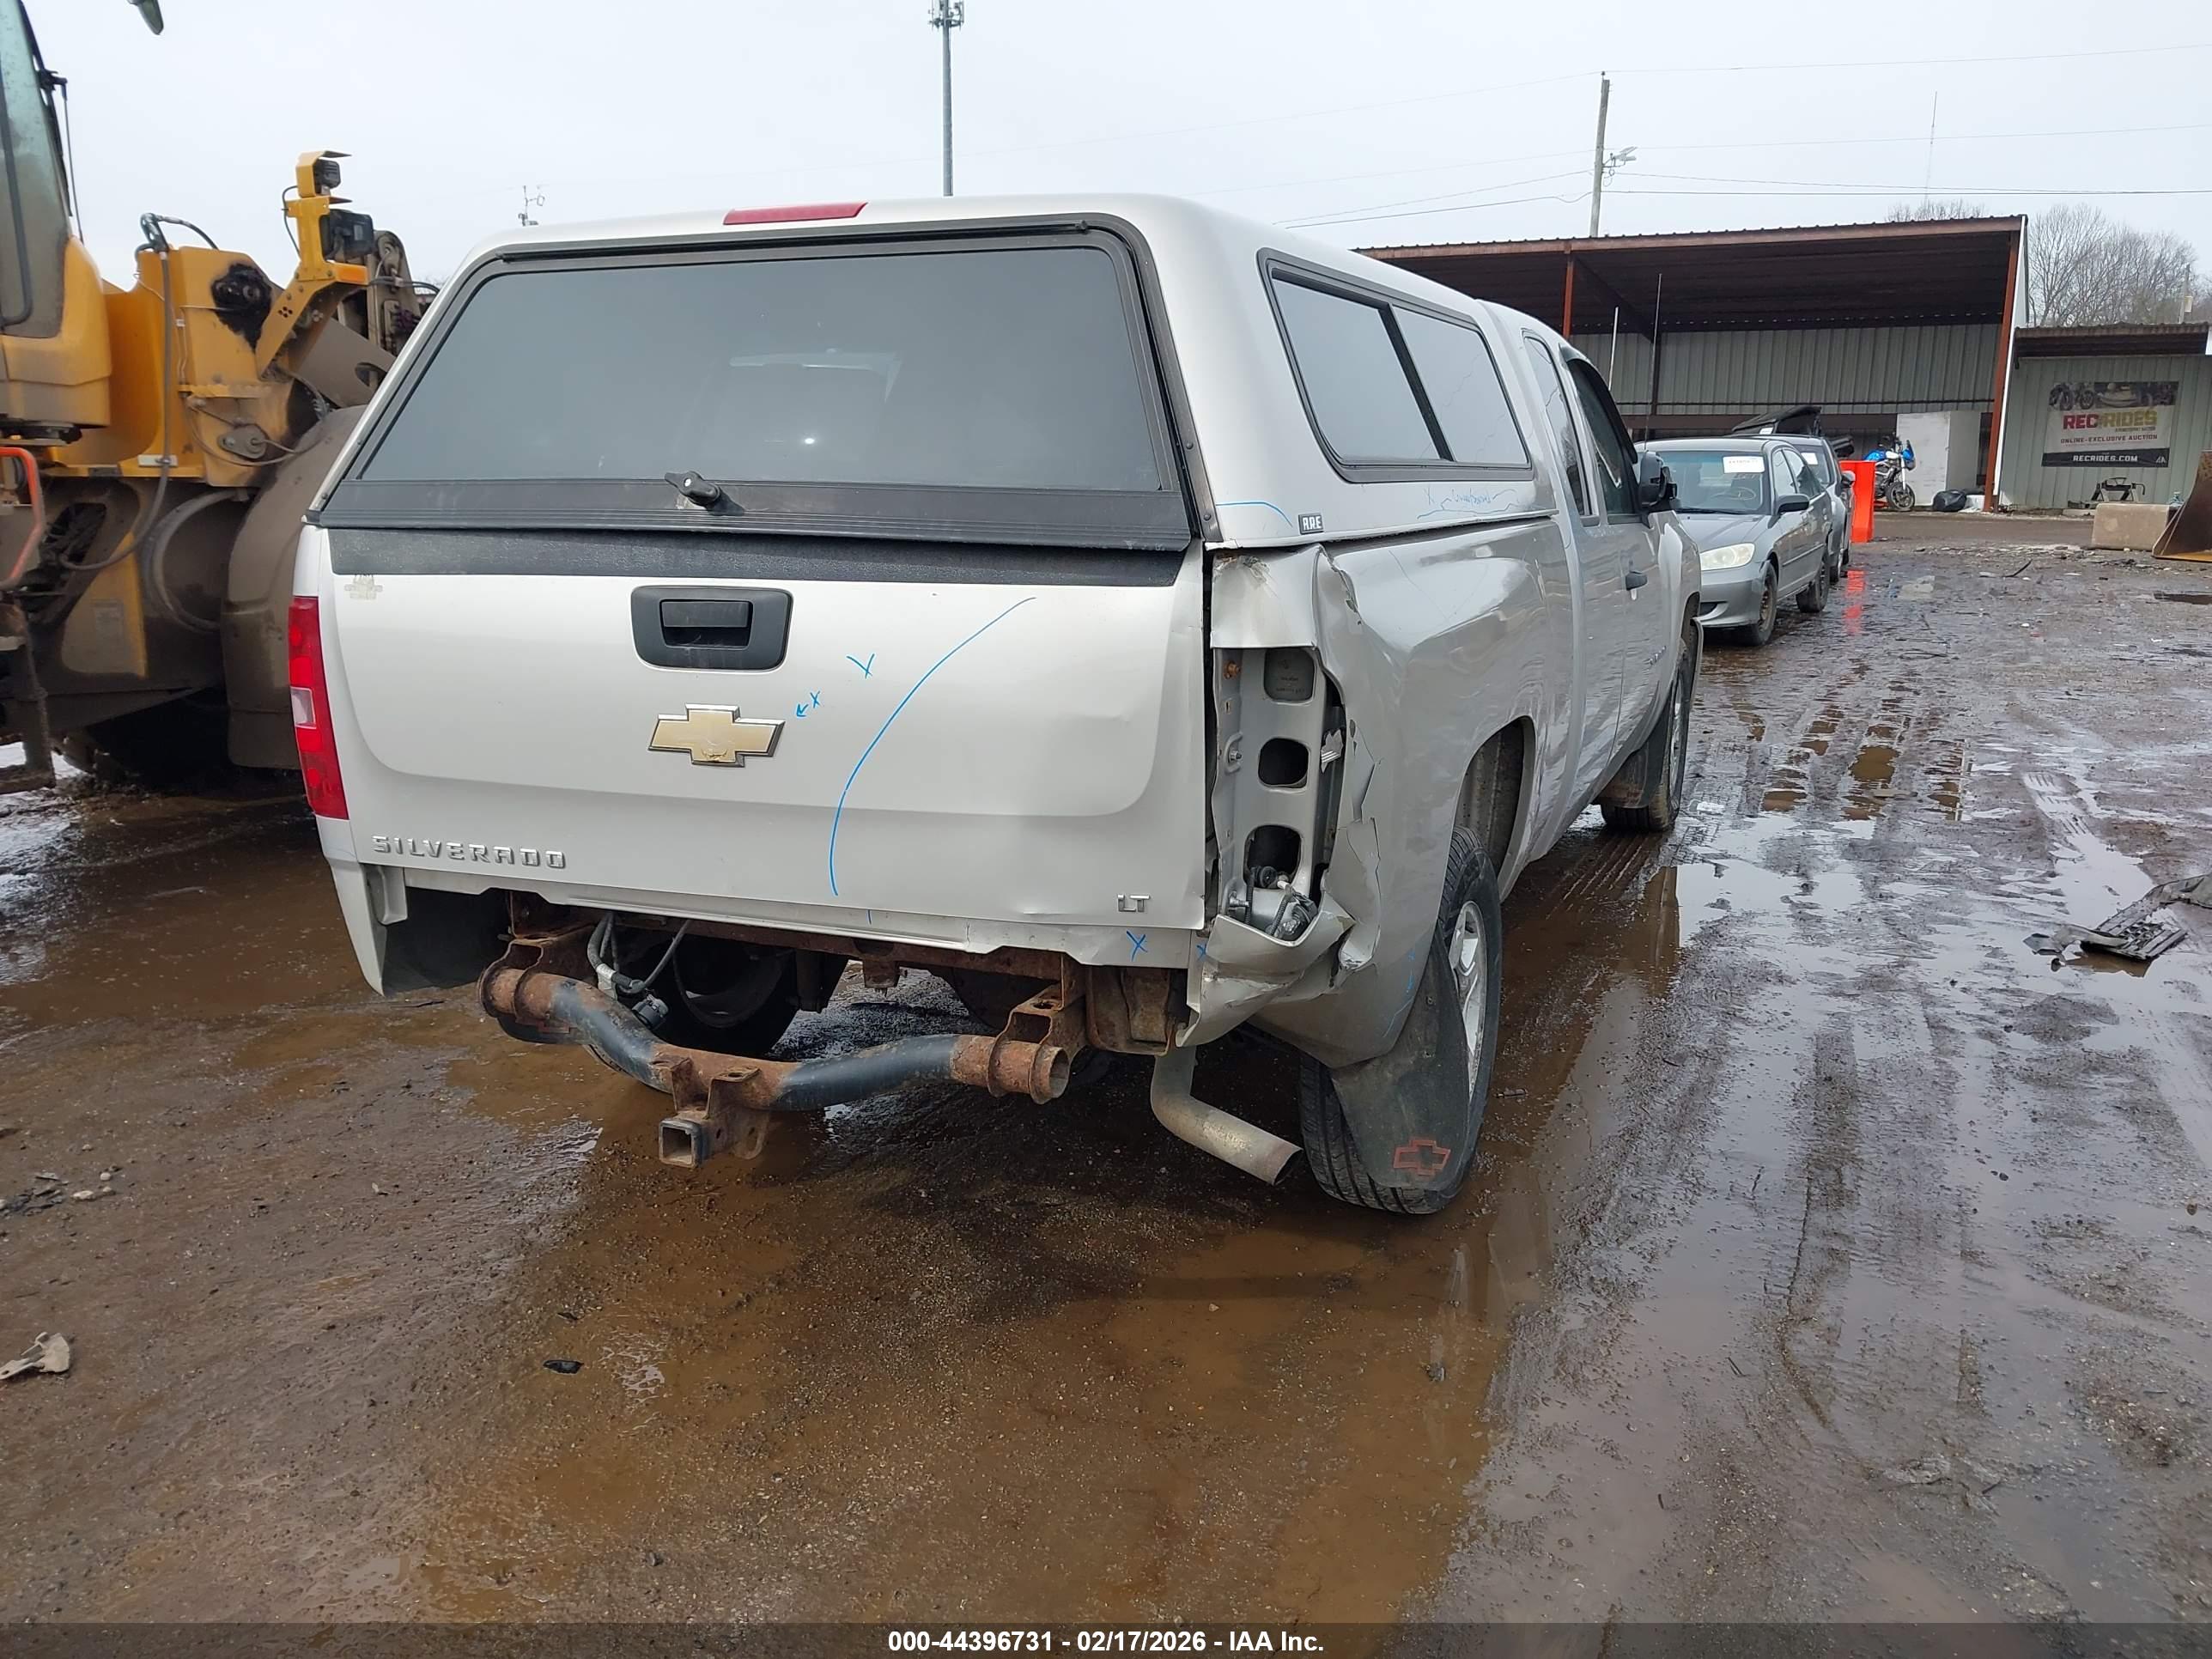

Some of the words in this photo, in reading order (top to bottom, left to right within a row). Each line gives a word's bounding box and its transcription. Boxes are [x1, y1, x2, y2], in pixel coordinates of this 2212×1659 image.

[2061, 435, 2126, 444] ONLINE-EXCLUSIVE
[372, 836, 567, 869] SILVERADO
[1117, 894, 1151, 913] LT
